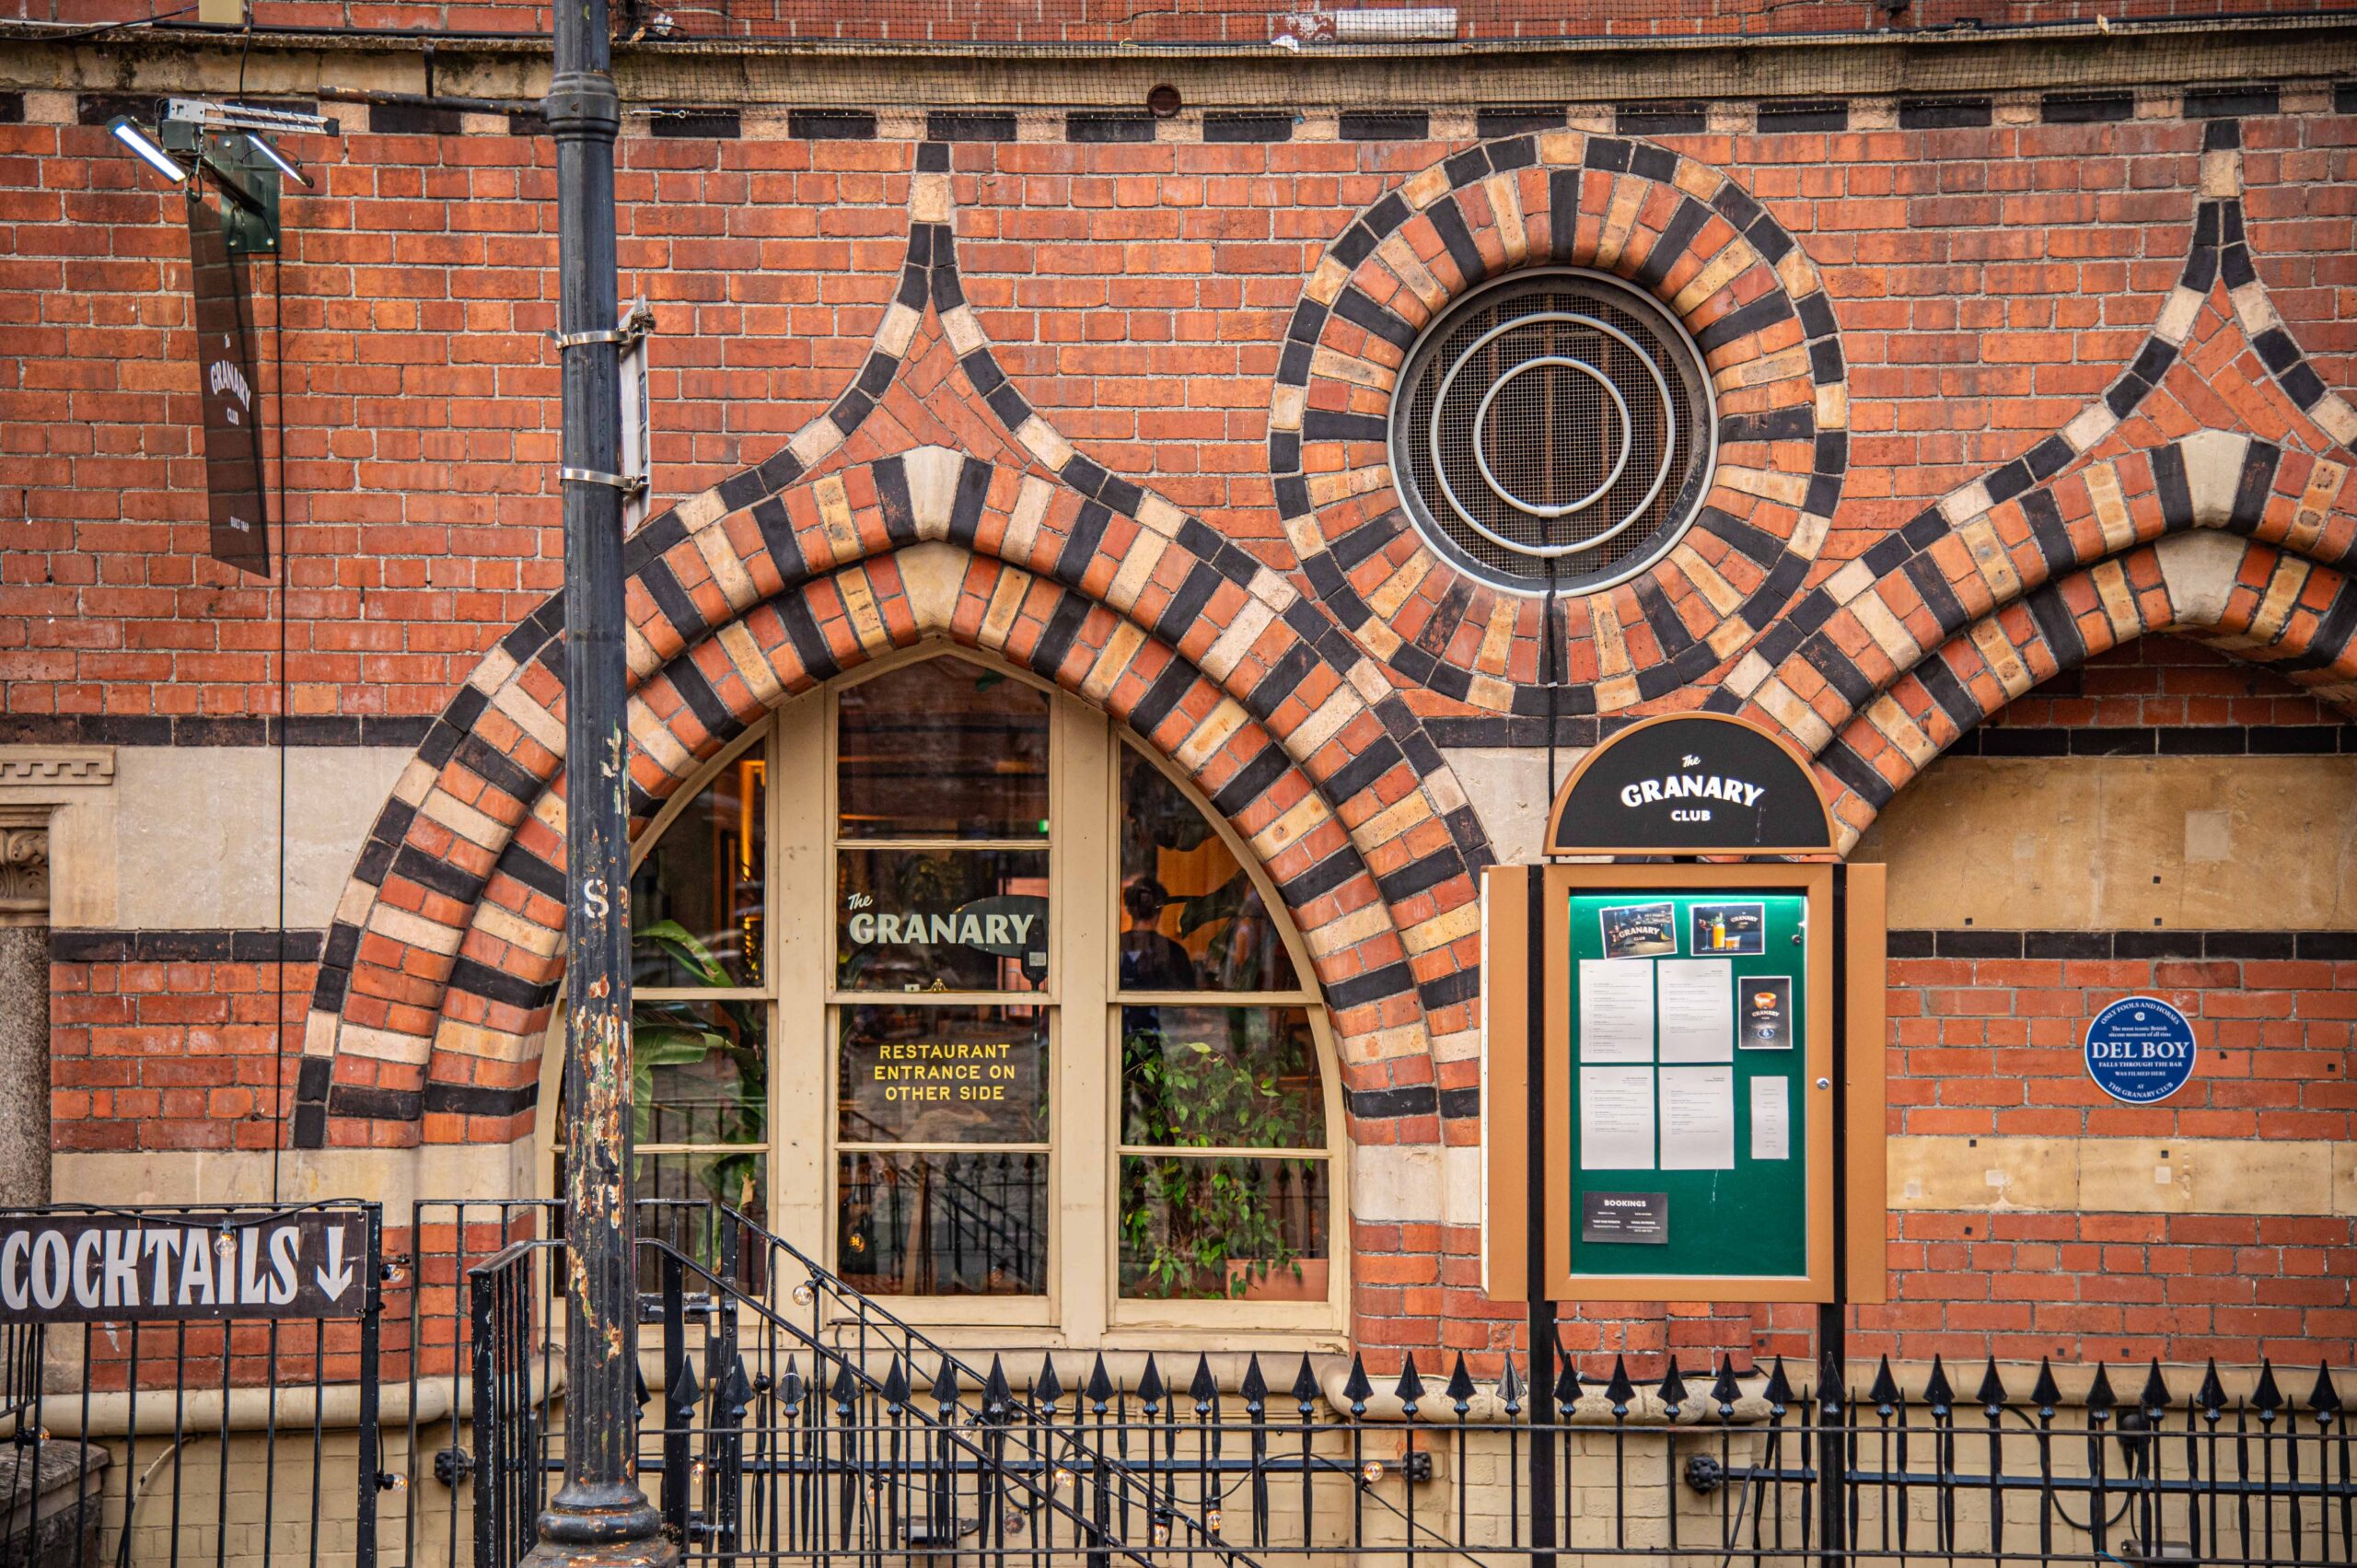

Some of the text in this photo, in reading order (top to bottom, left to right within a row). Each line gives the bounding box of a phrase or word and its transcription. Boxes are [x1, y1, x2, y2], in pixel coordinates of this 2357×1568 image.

[210, 360, 250, 412] GRANARY
[226, 407, 239, 425] CLUB
[1682, 754, 1701, 768] The
[1620, 775, 1765, 807] GRANARY
[1671, 810, 1711, 821] CLUB
[584, 879, 610, 919] S
[848, 892, 873, 911] The
[849, 913, 1034, 945] GRANARY
[1619, 926, 1660, 938] GRANARY
[2100, 1009, 2117, 1025] ONLY
[2118, 1002, 2140, 1013] FOOLS
[2140, 1002, 2156, 1010] AND
[2156, 1005, 2180, 1025] HORSES
[879, 1044, 1011, 1059] RESTAURANT
[2092, 1041, 2189, 1059] DEL BOY
[874, 1064, 1016, 1080] ENTRANCE ON
[885, 1086, 1004, 1100] OTHER SIDE
[2108, 1081, 2174, 1098] THE GRANARY CLUB
[1, 1226, 299, 1310] COCKTAILS
